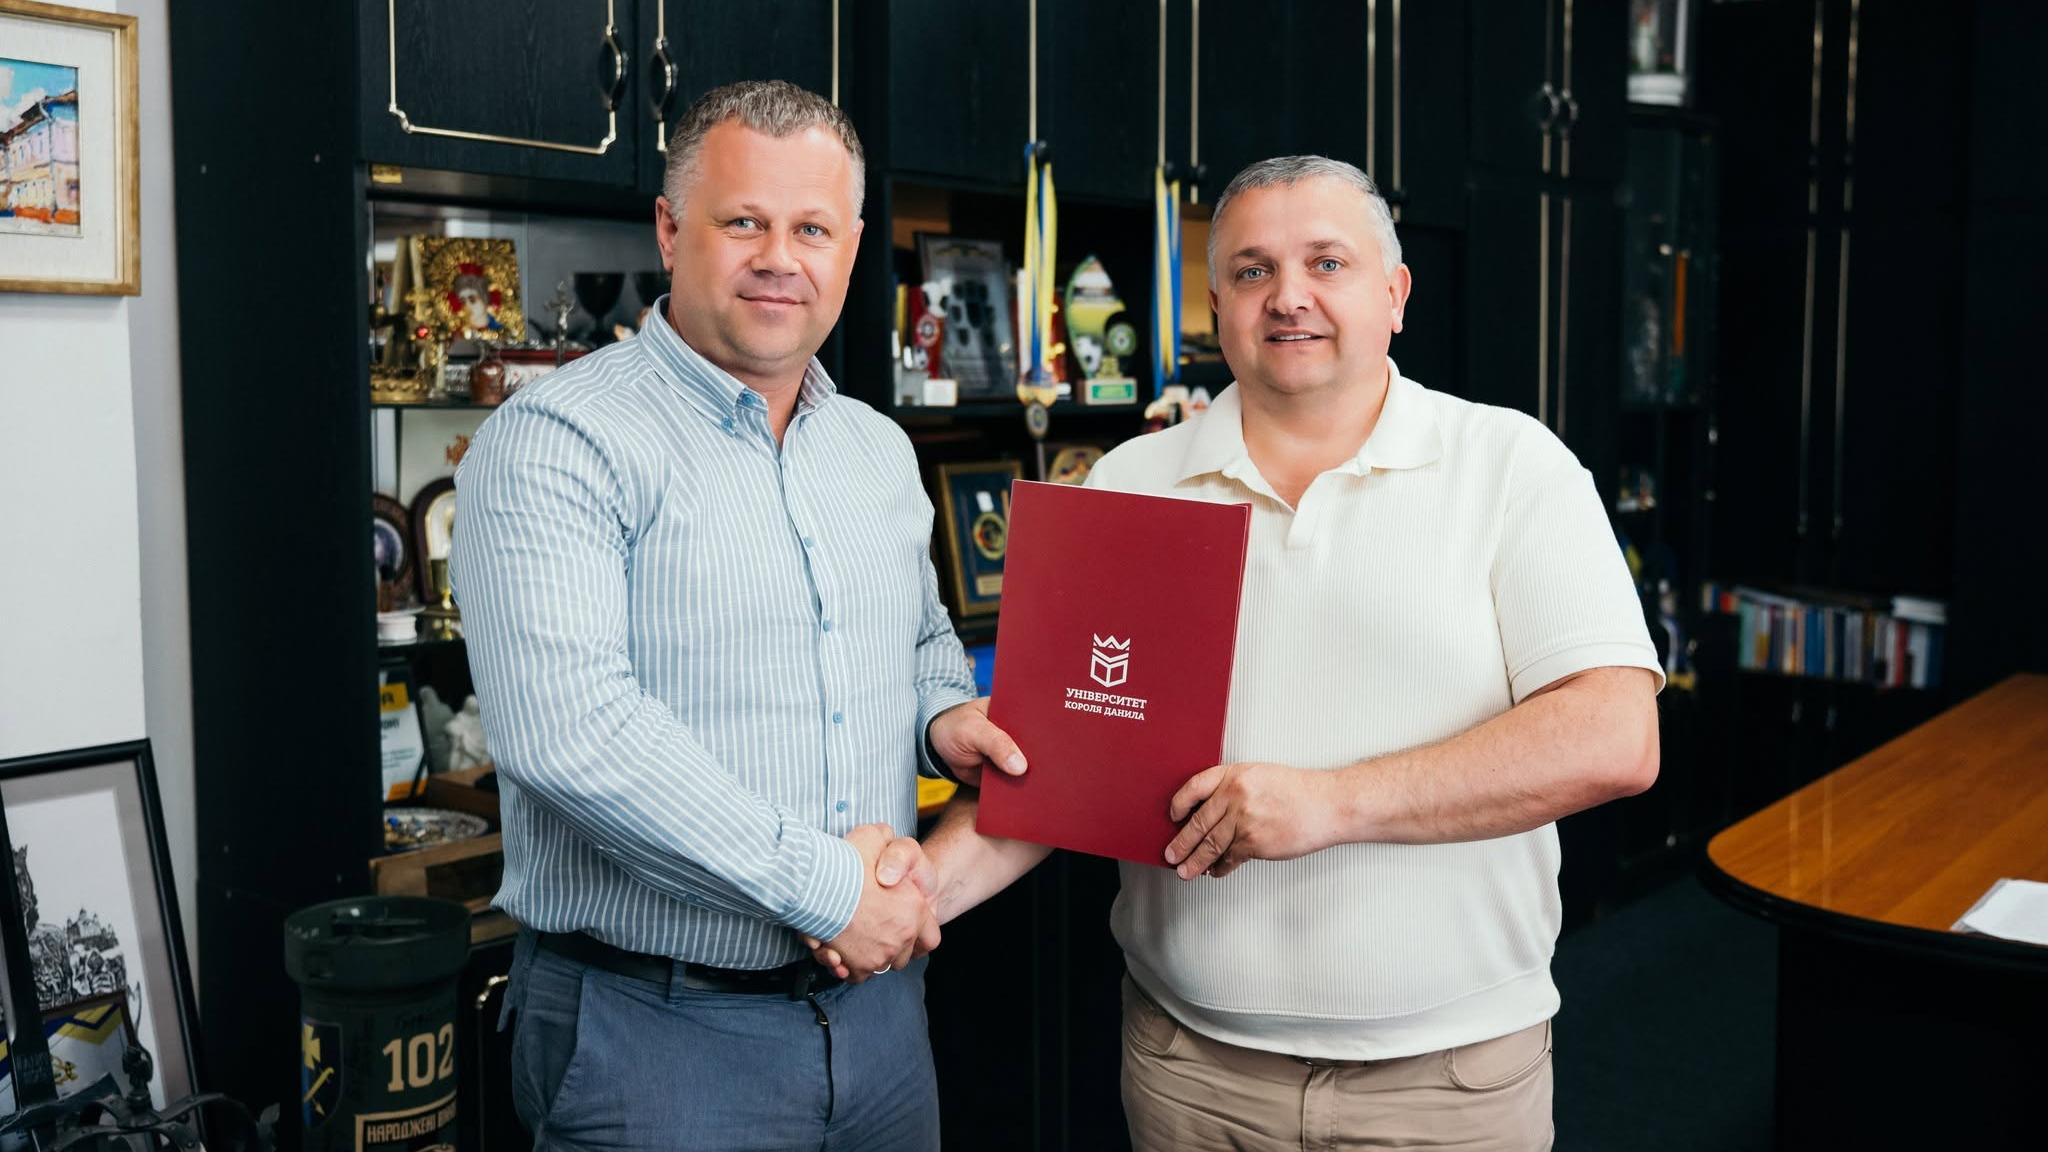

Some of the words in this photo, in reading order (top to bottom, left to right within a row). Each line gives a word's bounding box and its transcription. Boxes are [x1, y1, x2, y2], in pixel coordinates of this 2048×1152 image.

[1064, 700, 1102, 713] КОРОЛЯ
[1104, 707, 1145, 720] ДАНИЛА
[1066, 687, 1147, 708] УНІВЕРСИТЕТ
[382, 1022, 455, 1093] 102
[367, 1113, 436, 1143] НАРОДЖЕНІ
